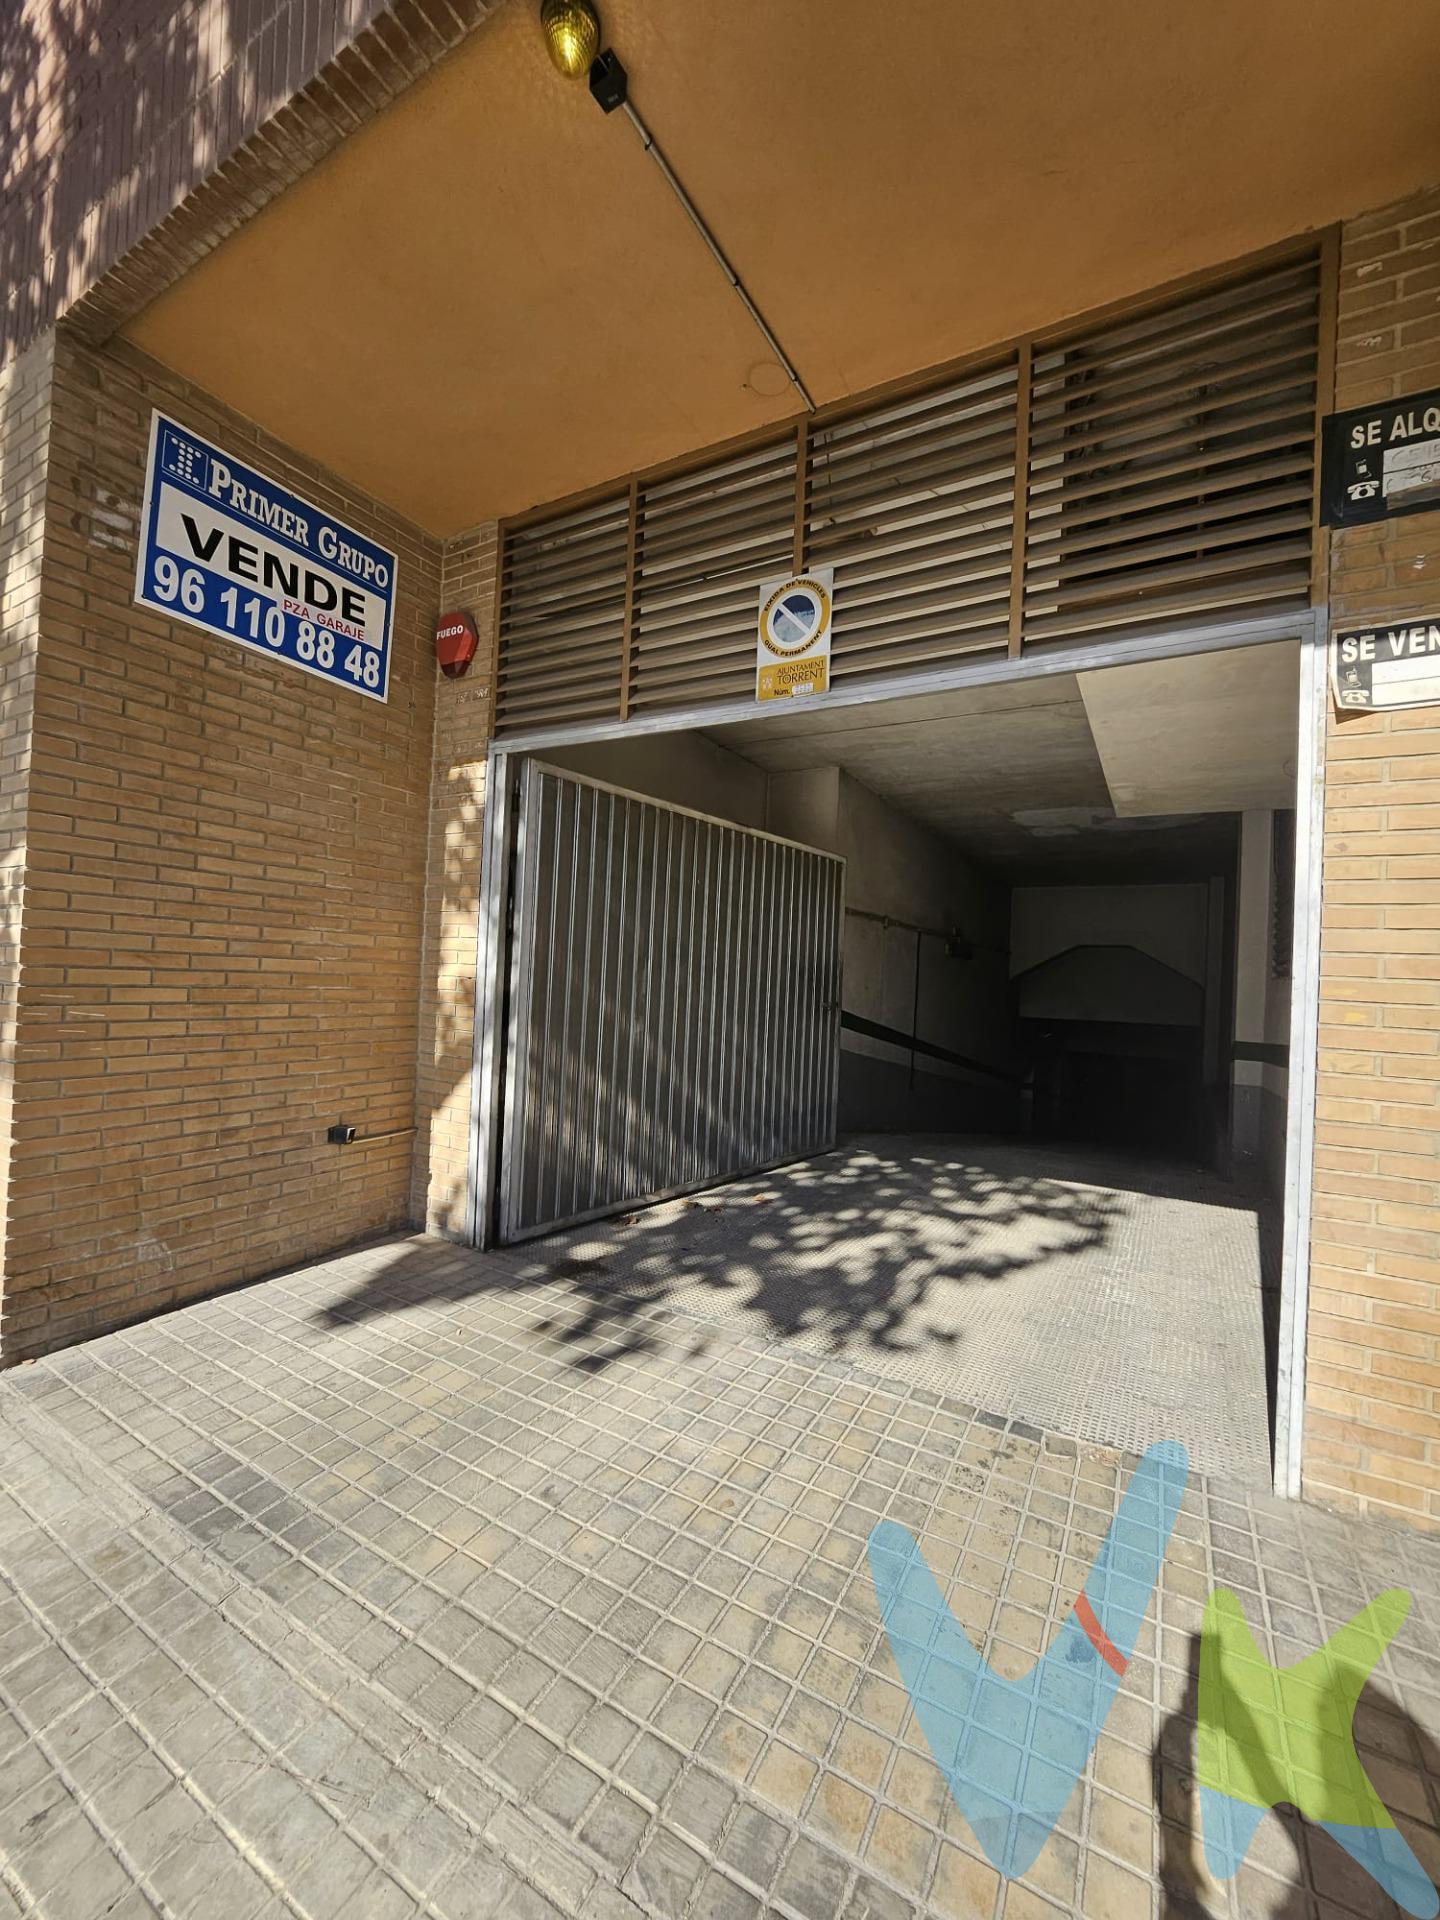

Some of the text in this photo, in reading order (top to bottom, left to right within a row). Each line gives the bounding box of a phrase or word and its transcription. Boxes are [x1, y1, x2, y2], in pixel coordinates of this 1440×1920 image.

[1350, 420, 1382, 448] SE
[208, 458, 389, 588] PRIMER GRUPO
[180, 513, 366, 627] VENDE
[798, 579, 825, 599] VEHICLES
[153, 555, 380, 688] 96 110 88 48
[283, 599, 365, 641] PZA GARAJE
[436, 625, 464, 640] FUEGO
[780, 630, 822, 656] PERMANENT
[1341, 634, 1376, 662] SE
[776, 667, 825, 685] TORRENT
[777, 659, 824, 675] AJUNTAMENT
